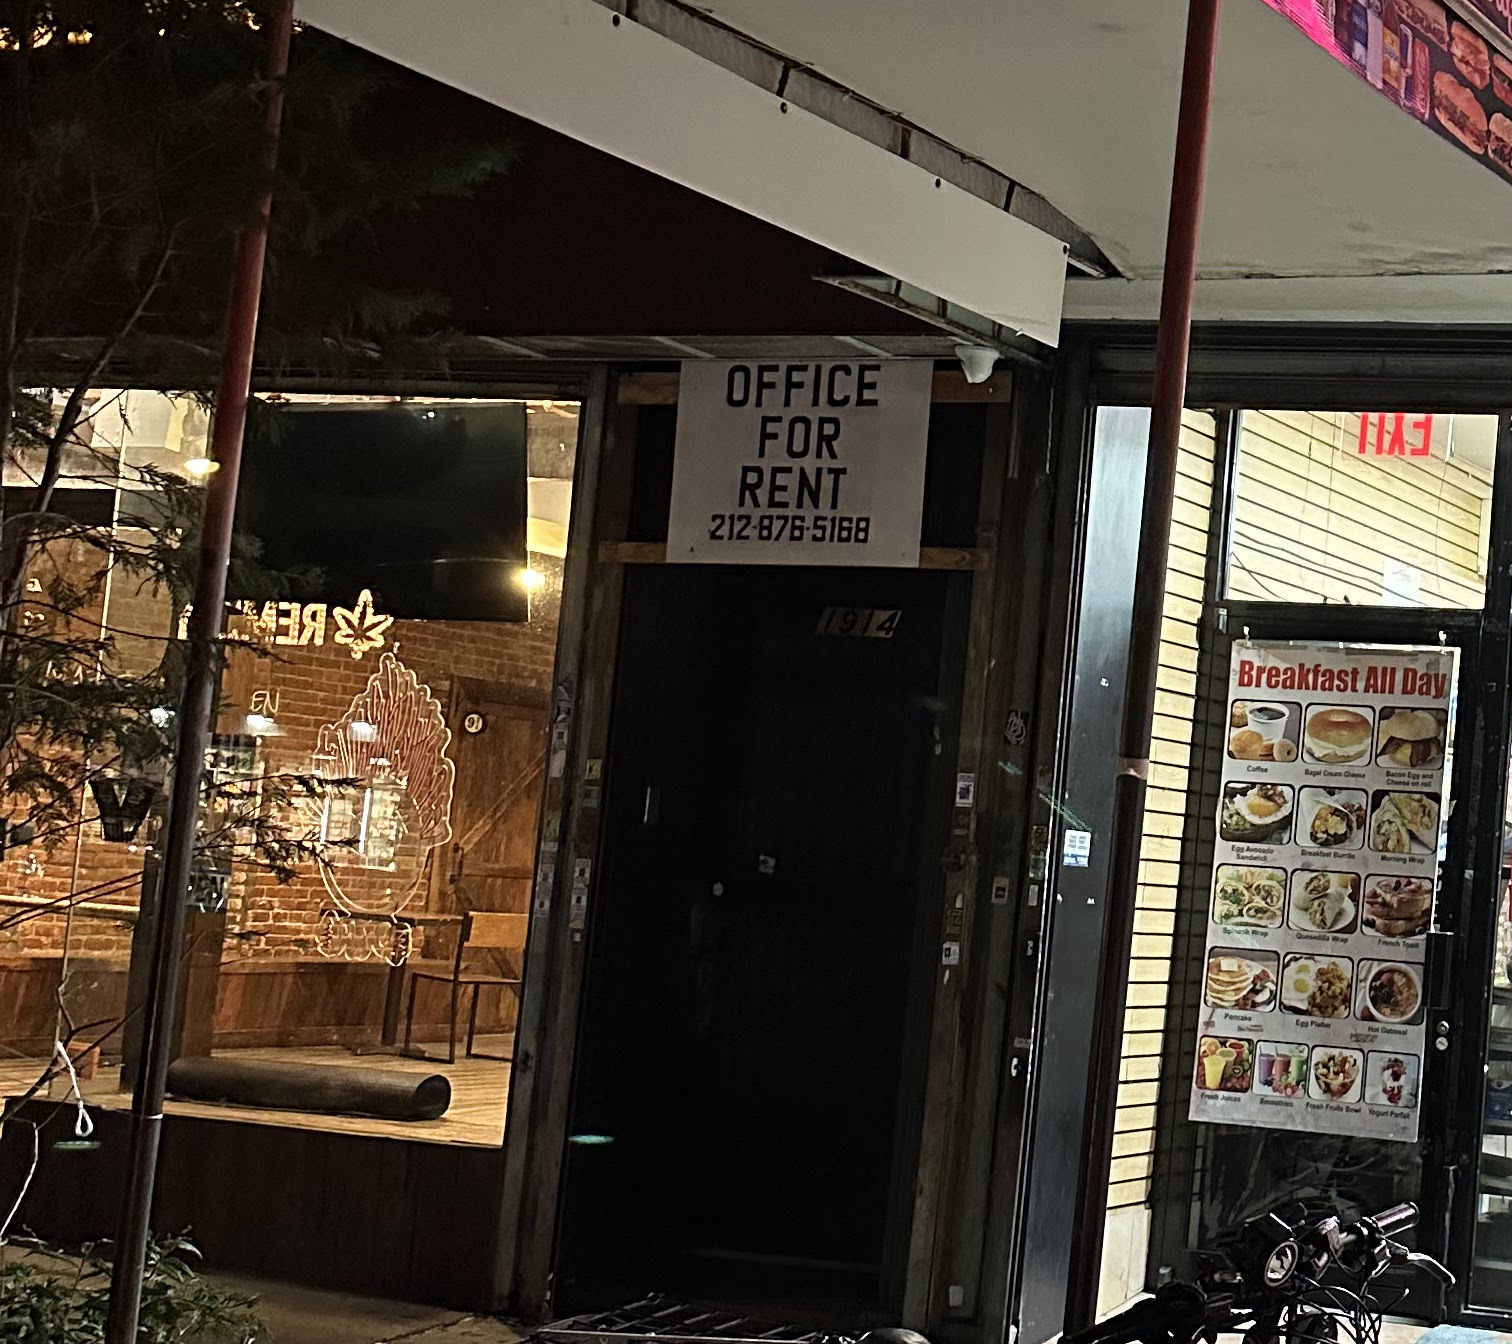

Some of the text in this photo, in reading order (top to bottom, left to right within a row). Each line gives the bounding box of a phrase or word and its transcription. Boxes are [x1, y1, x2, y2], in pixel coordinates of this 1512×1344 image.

[725, 364, 882, 408] OFFICE
[757, 415, 842, 460] FOR
[737, 465, 848, 510] RENT
[708, 513, 871, 544] 212-876-5168
[823, 609, 899, 636] 1914
[1238, 659, 1448, 700] Breakfast All Day
[1246, 764, 1269, 774] Coffee
[1304, 768, 1322, 778] Bagel
[1324, 770, 1342, 778] Cream
[1385, 770, 1434, 781] Bacon Egg and
[1231, 844, 1275, 855] Egg Avocado
[1300, 849, 1332, 858] Breakfast
[1380, 854, 1425, 865] Morning Wrap
[1378, 939, 1400, 948] French
[1295, 1019, 1309, 1028] Egg
[1368, 1026, 1380, 1034] Hot
[1200, 1092, 1219, 1102] Fresh
[1306, 1102, 1324, 1111] Fresh
[1344, 1105, 1361, 1113] Bowl
[1368, 1108, 1389, 1118] Yogurt
